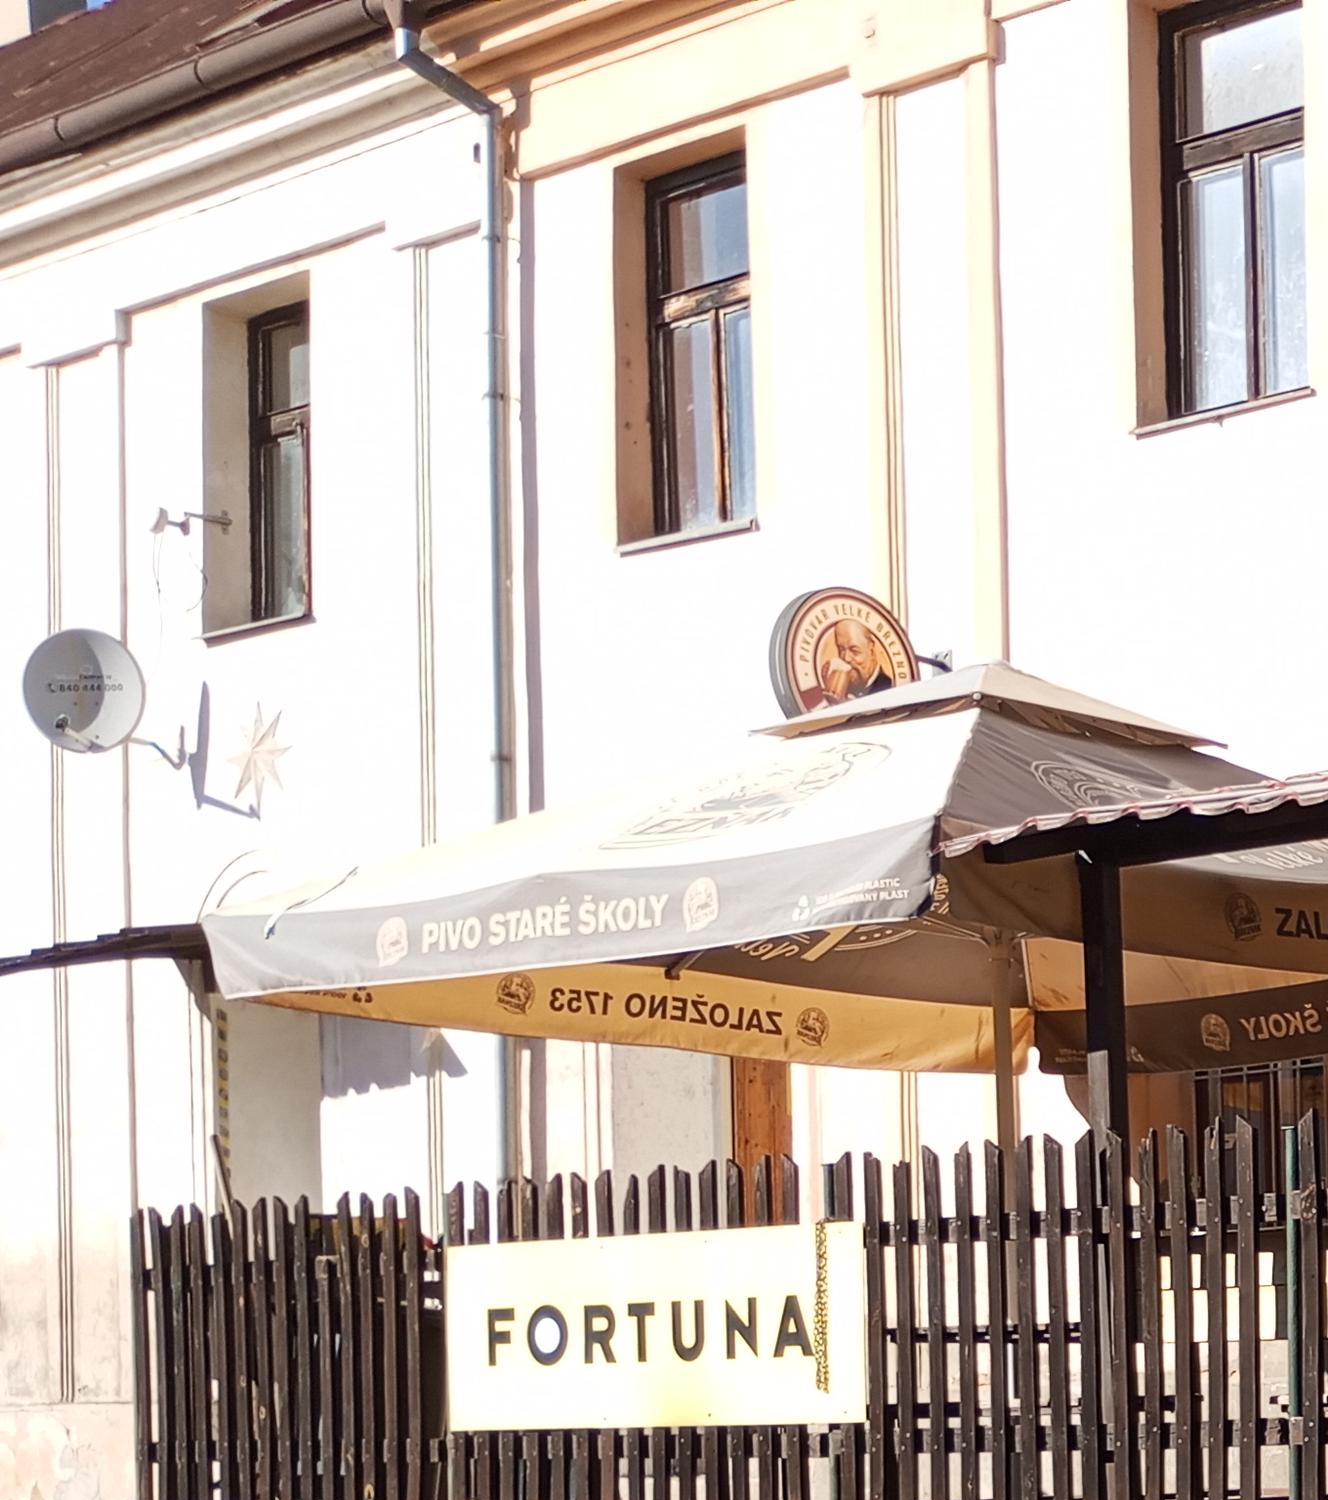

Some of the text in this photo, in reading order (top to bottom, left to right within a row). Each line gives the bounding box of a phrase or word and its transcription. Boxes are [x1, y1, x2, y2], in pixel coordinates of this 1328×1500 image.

[421, 893, 670, 953] PIVO STARÉ ŠKOLY
[487, 1295, 815, 1366] FORTUNA
